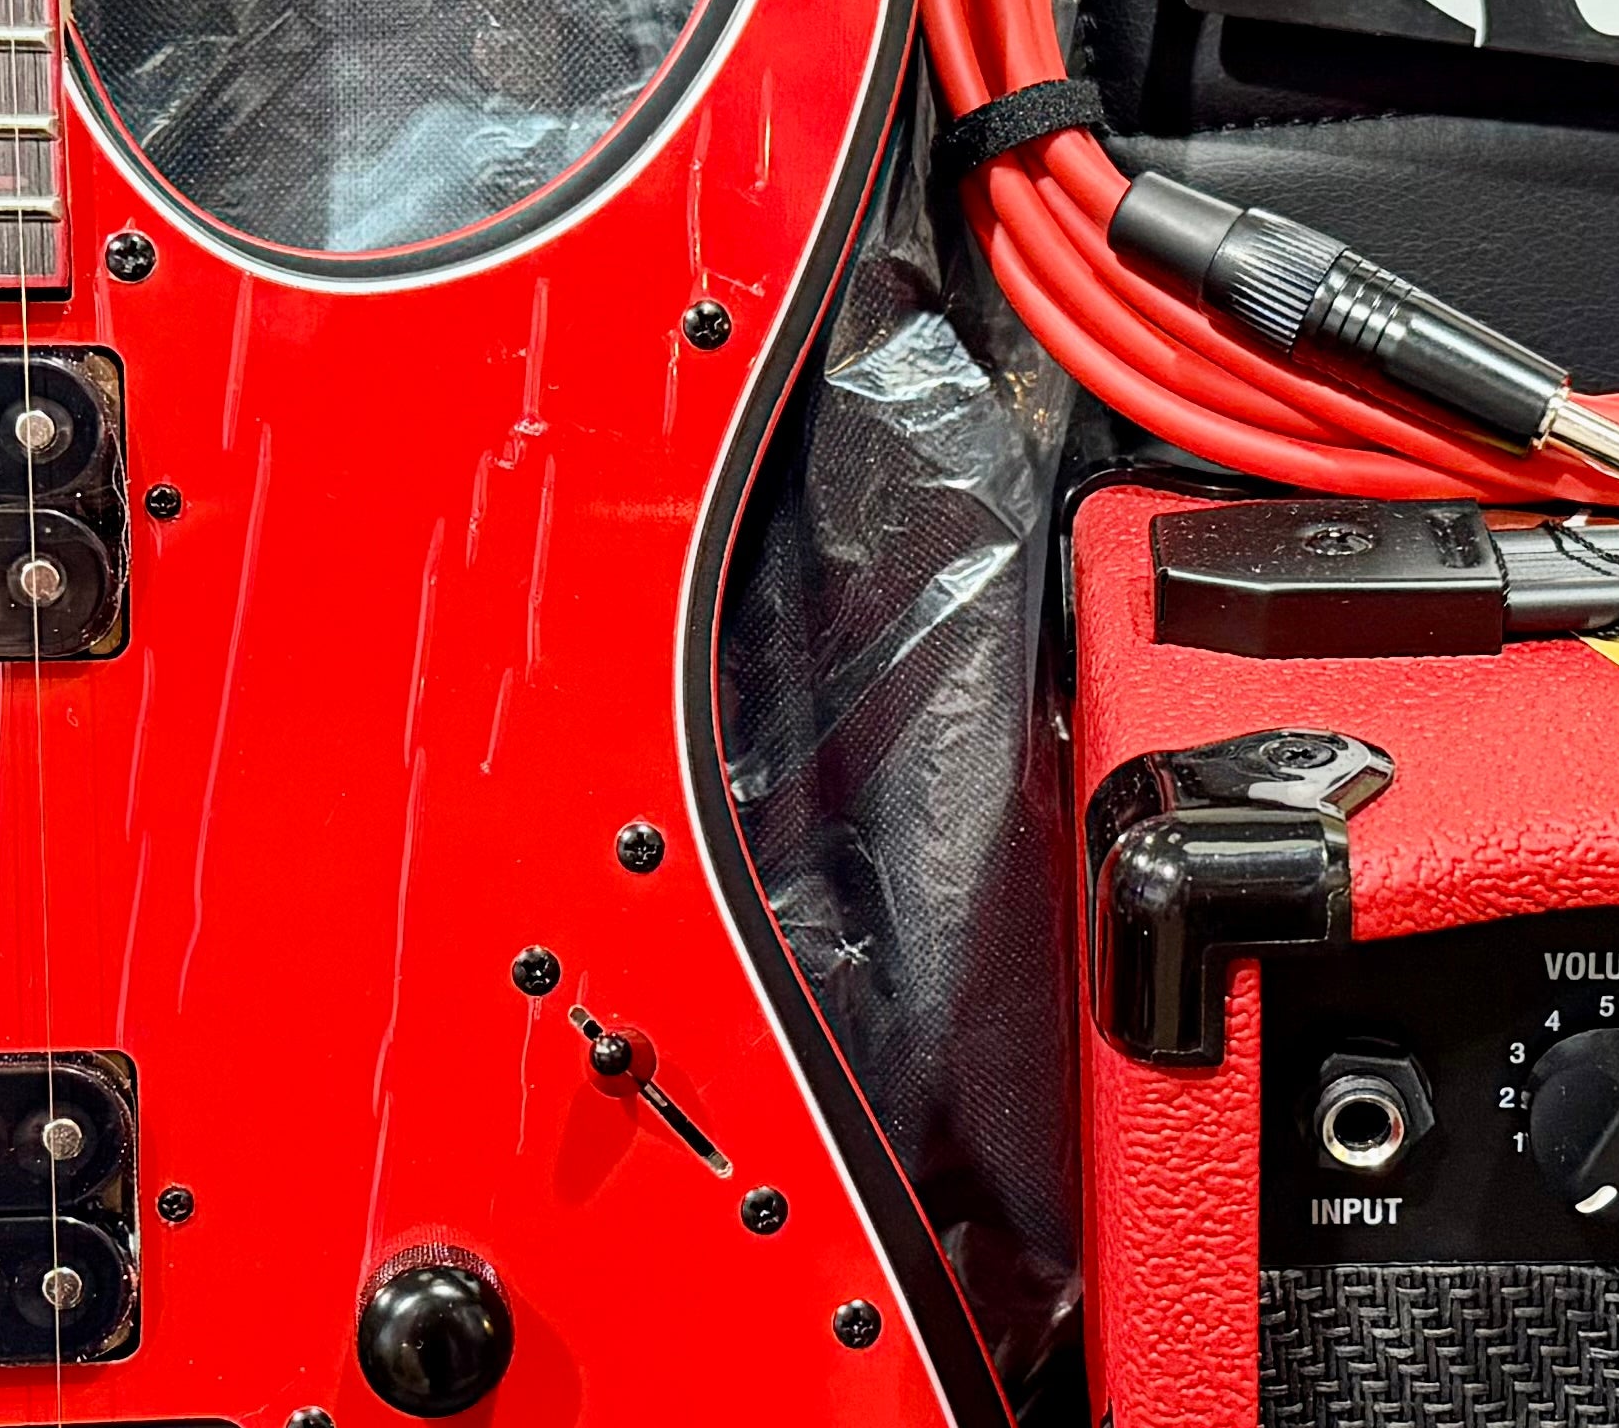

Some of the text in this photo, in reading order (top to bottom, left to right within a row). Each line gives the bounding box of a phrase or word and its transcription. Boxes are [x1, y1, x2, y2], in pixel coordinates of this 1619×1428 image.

[1599, 995, 1617, 1017] 5
[1544, 1010, 1562, 1033] 4
[1510, 1042, 1526, 1065] 3
[1499, 1086, 1514, 1108] 2
[1513, 1132, 1525, 1154] 1
[1310, 1198, 1403, 1226] INPUT
